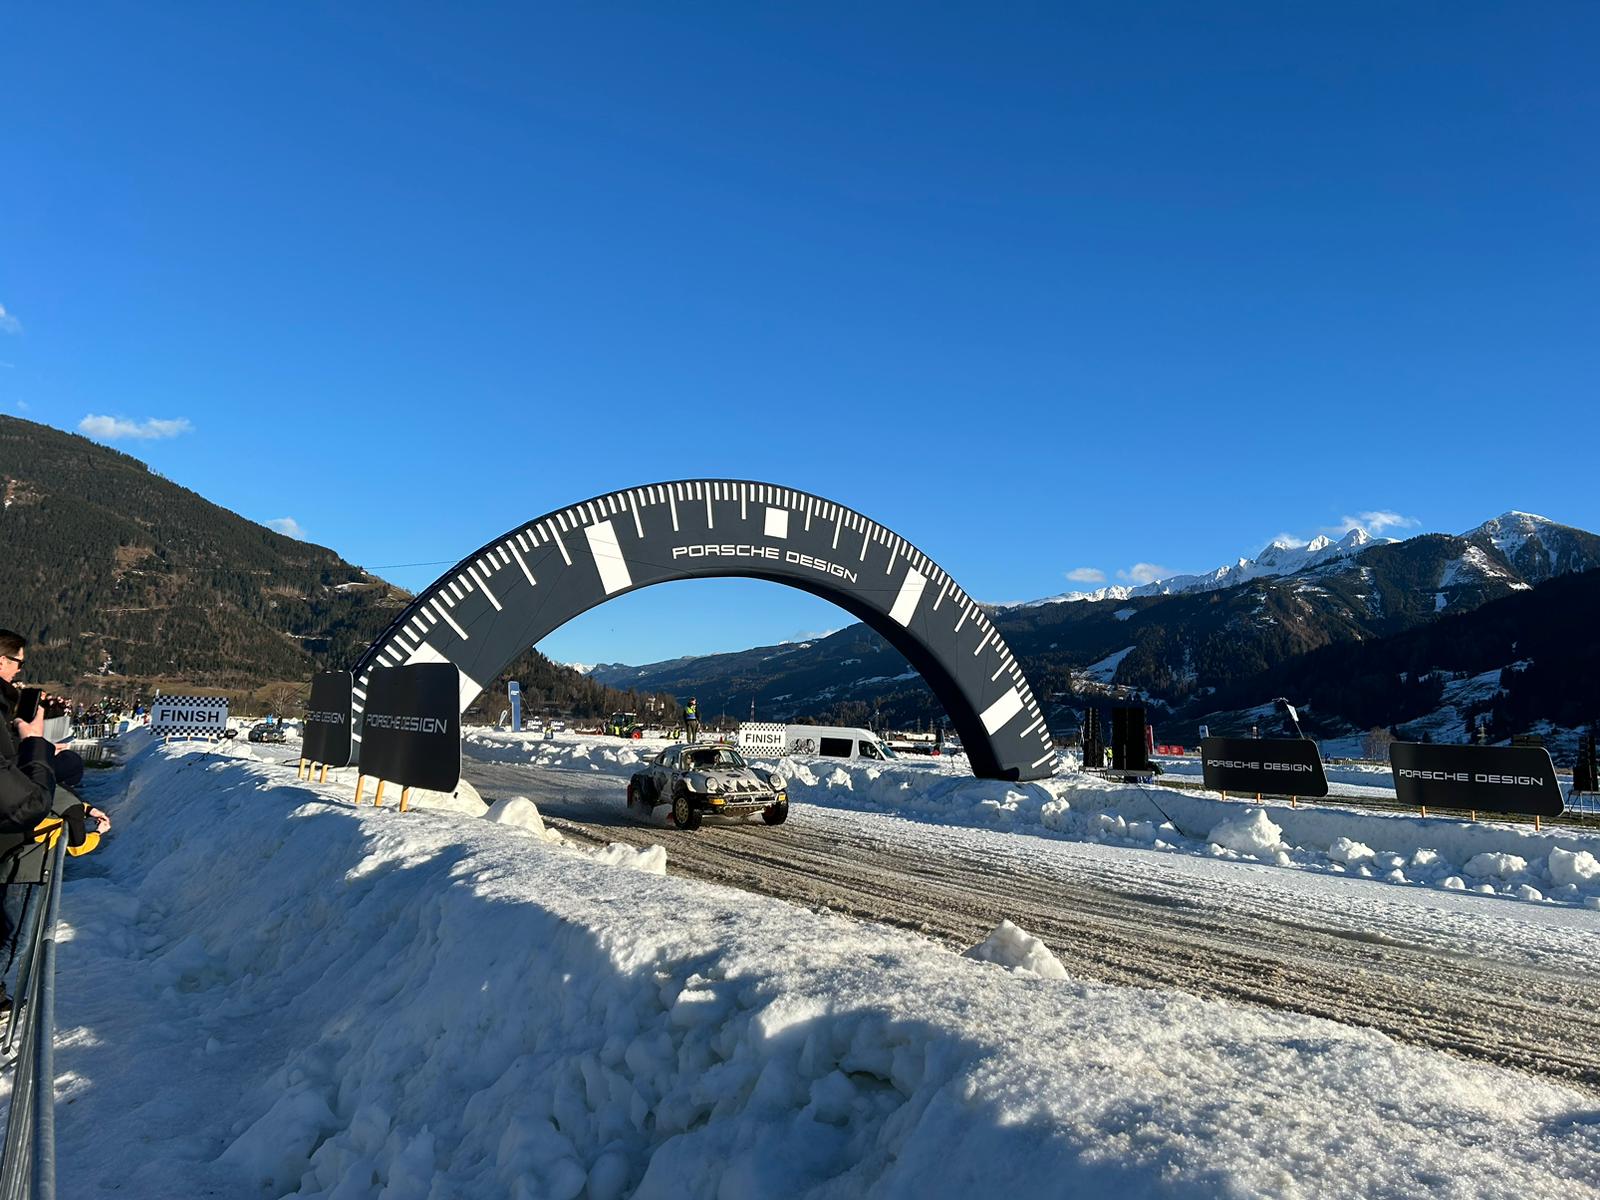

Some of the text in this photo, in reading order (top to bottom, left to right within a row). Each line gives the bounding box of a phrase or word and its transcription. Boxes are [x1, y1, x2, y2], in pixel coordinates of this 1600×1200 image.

[672, 545, 858, 584] PORSCHE DESIGN
[160, 709, 220, 723] FINISH
[366, 713, 448, 734] PORSCHE DESIGN
[745, 733, 781, 744] FINISH
[1207, 759, 1313, 772] PORSCHE DESIGN
[1399, 768, 1543, 785] PORSCHE DESIGN
